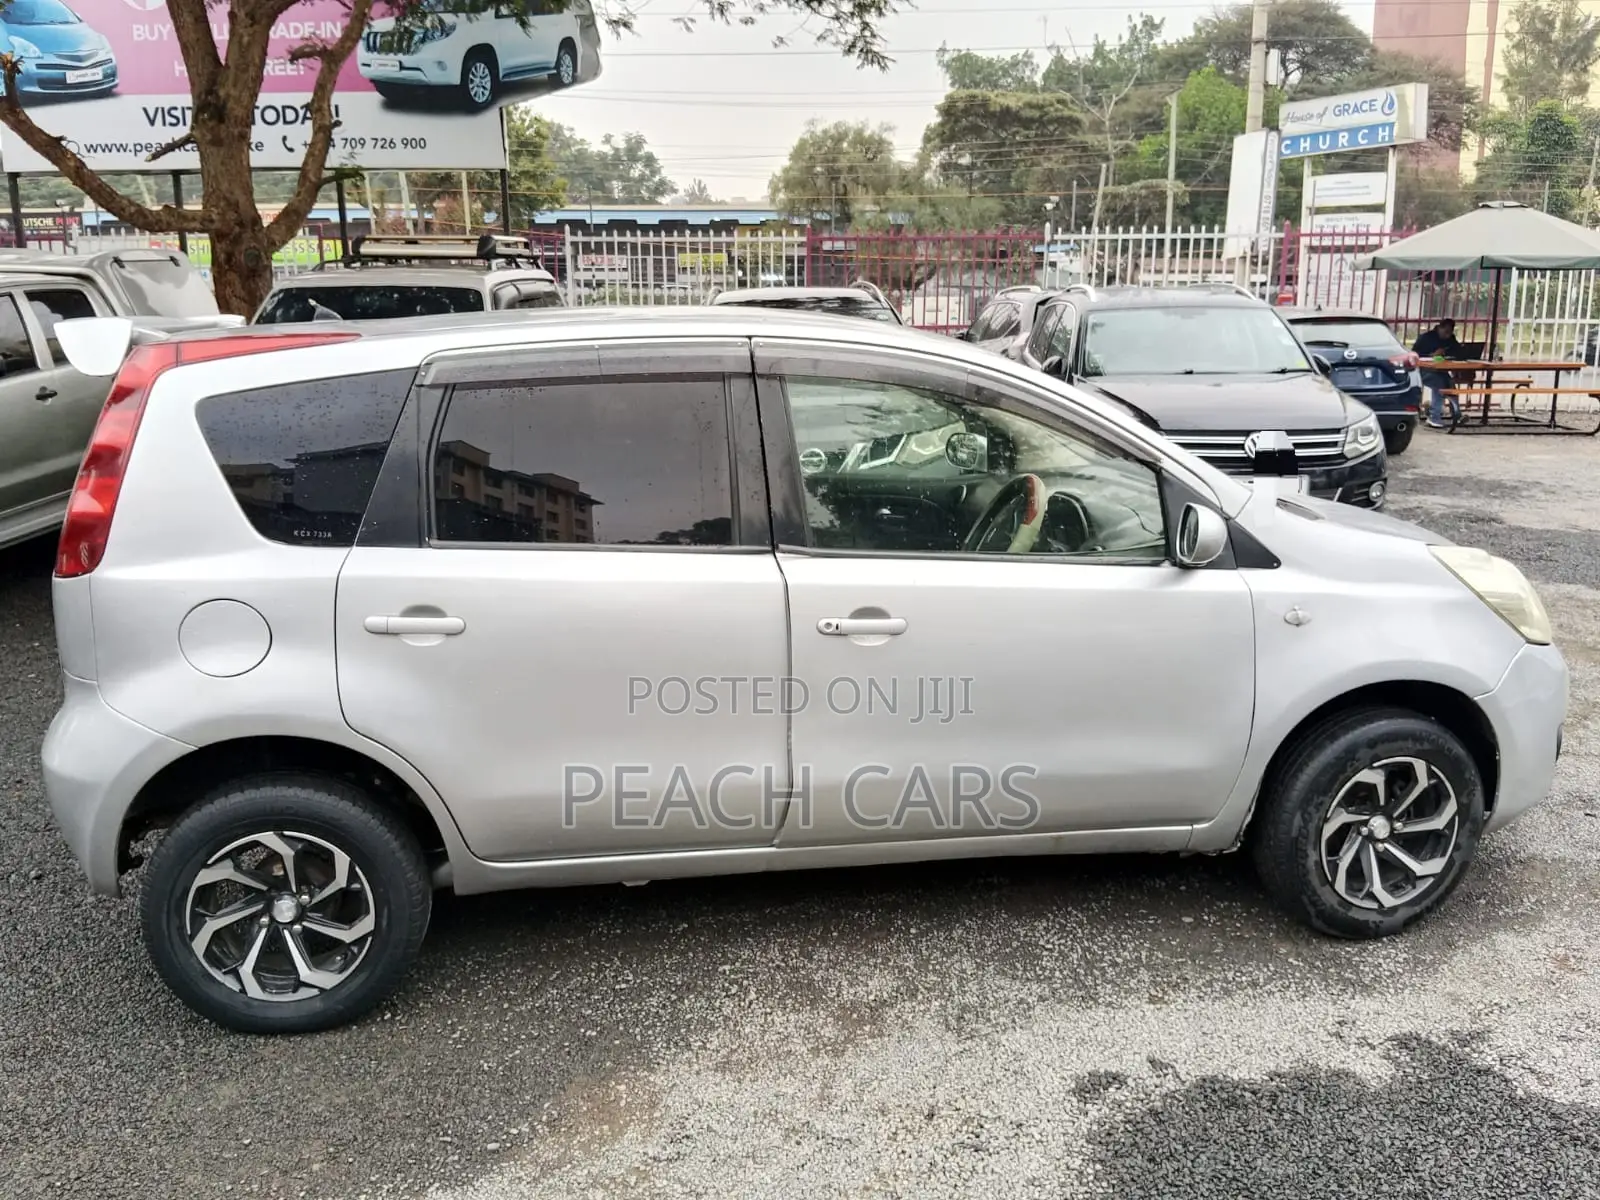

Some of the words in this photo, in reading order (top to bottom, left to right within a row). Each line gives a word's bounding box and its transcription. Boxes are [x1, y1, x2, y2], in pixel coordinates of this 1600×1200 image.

[132, 24, 171, 41] BUY
[251, 104, 340, 126] TODA!
[1282, 112, 1314, 126] House
[1316, 105, 1329, 126] of
[1333, 99, 1378, 118] GRACE
[341, 138, 367, 150] 709
[371, 138, 397, 150] 726
[401, 137, 428, 150] 900
[1281, 126, 1389, 155] CHURCH
[23, 217, 55, 227] UTSCHE
